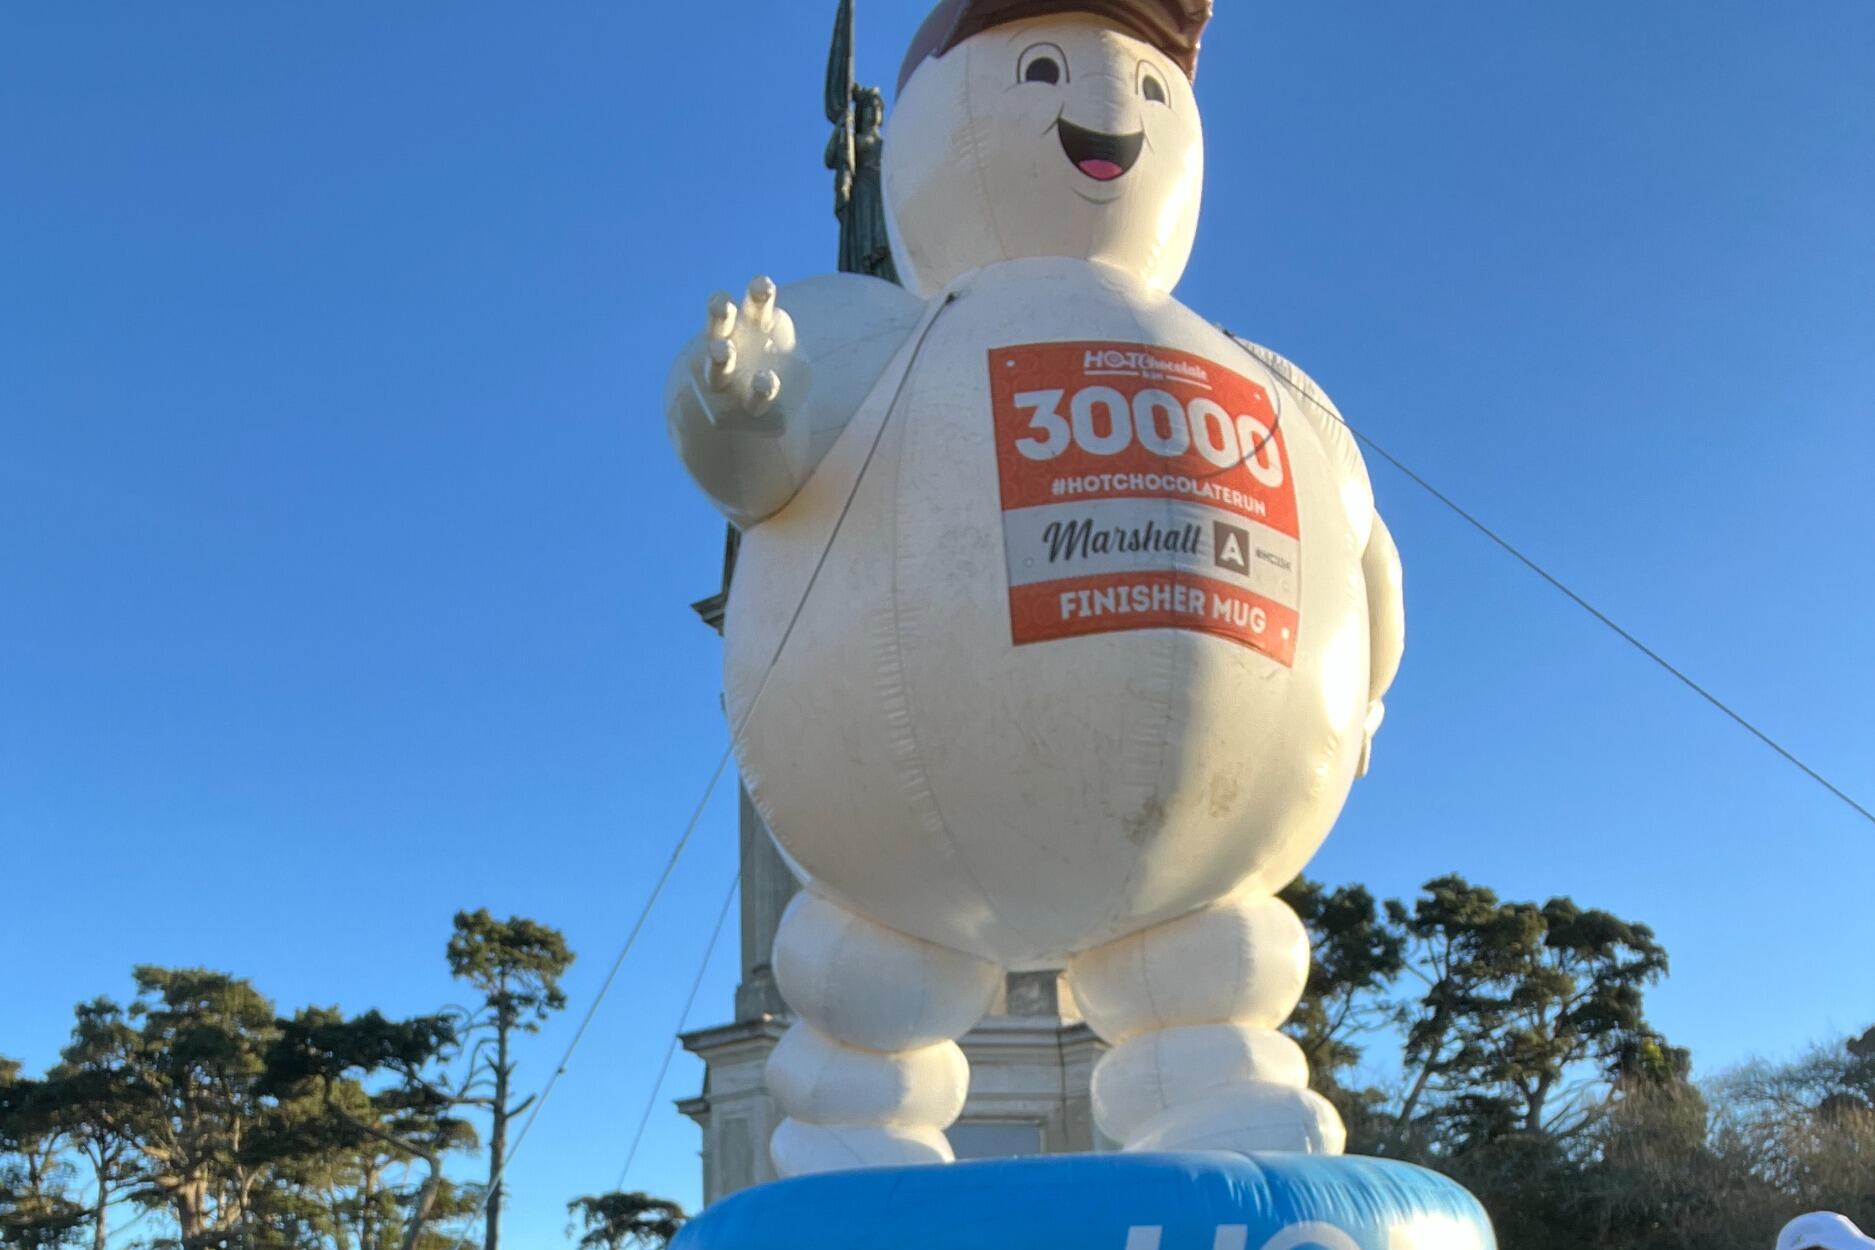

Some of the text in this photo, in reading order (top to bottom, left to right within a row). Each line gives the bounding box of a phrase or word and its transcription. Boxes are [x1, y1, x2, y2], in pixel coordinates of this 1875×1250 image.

[1084, 350, 1139, 368] HOT
[1014, 386, 1283, 487] 30000
[1052, 474, 1265, 517] #HOTCHOCOLATERUN
[1042, 518, 1202, 563] Marshall
[1220, 532, 1245, 567] A
[1060, 584, 1267, 633] FINISHER MUG
